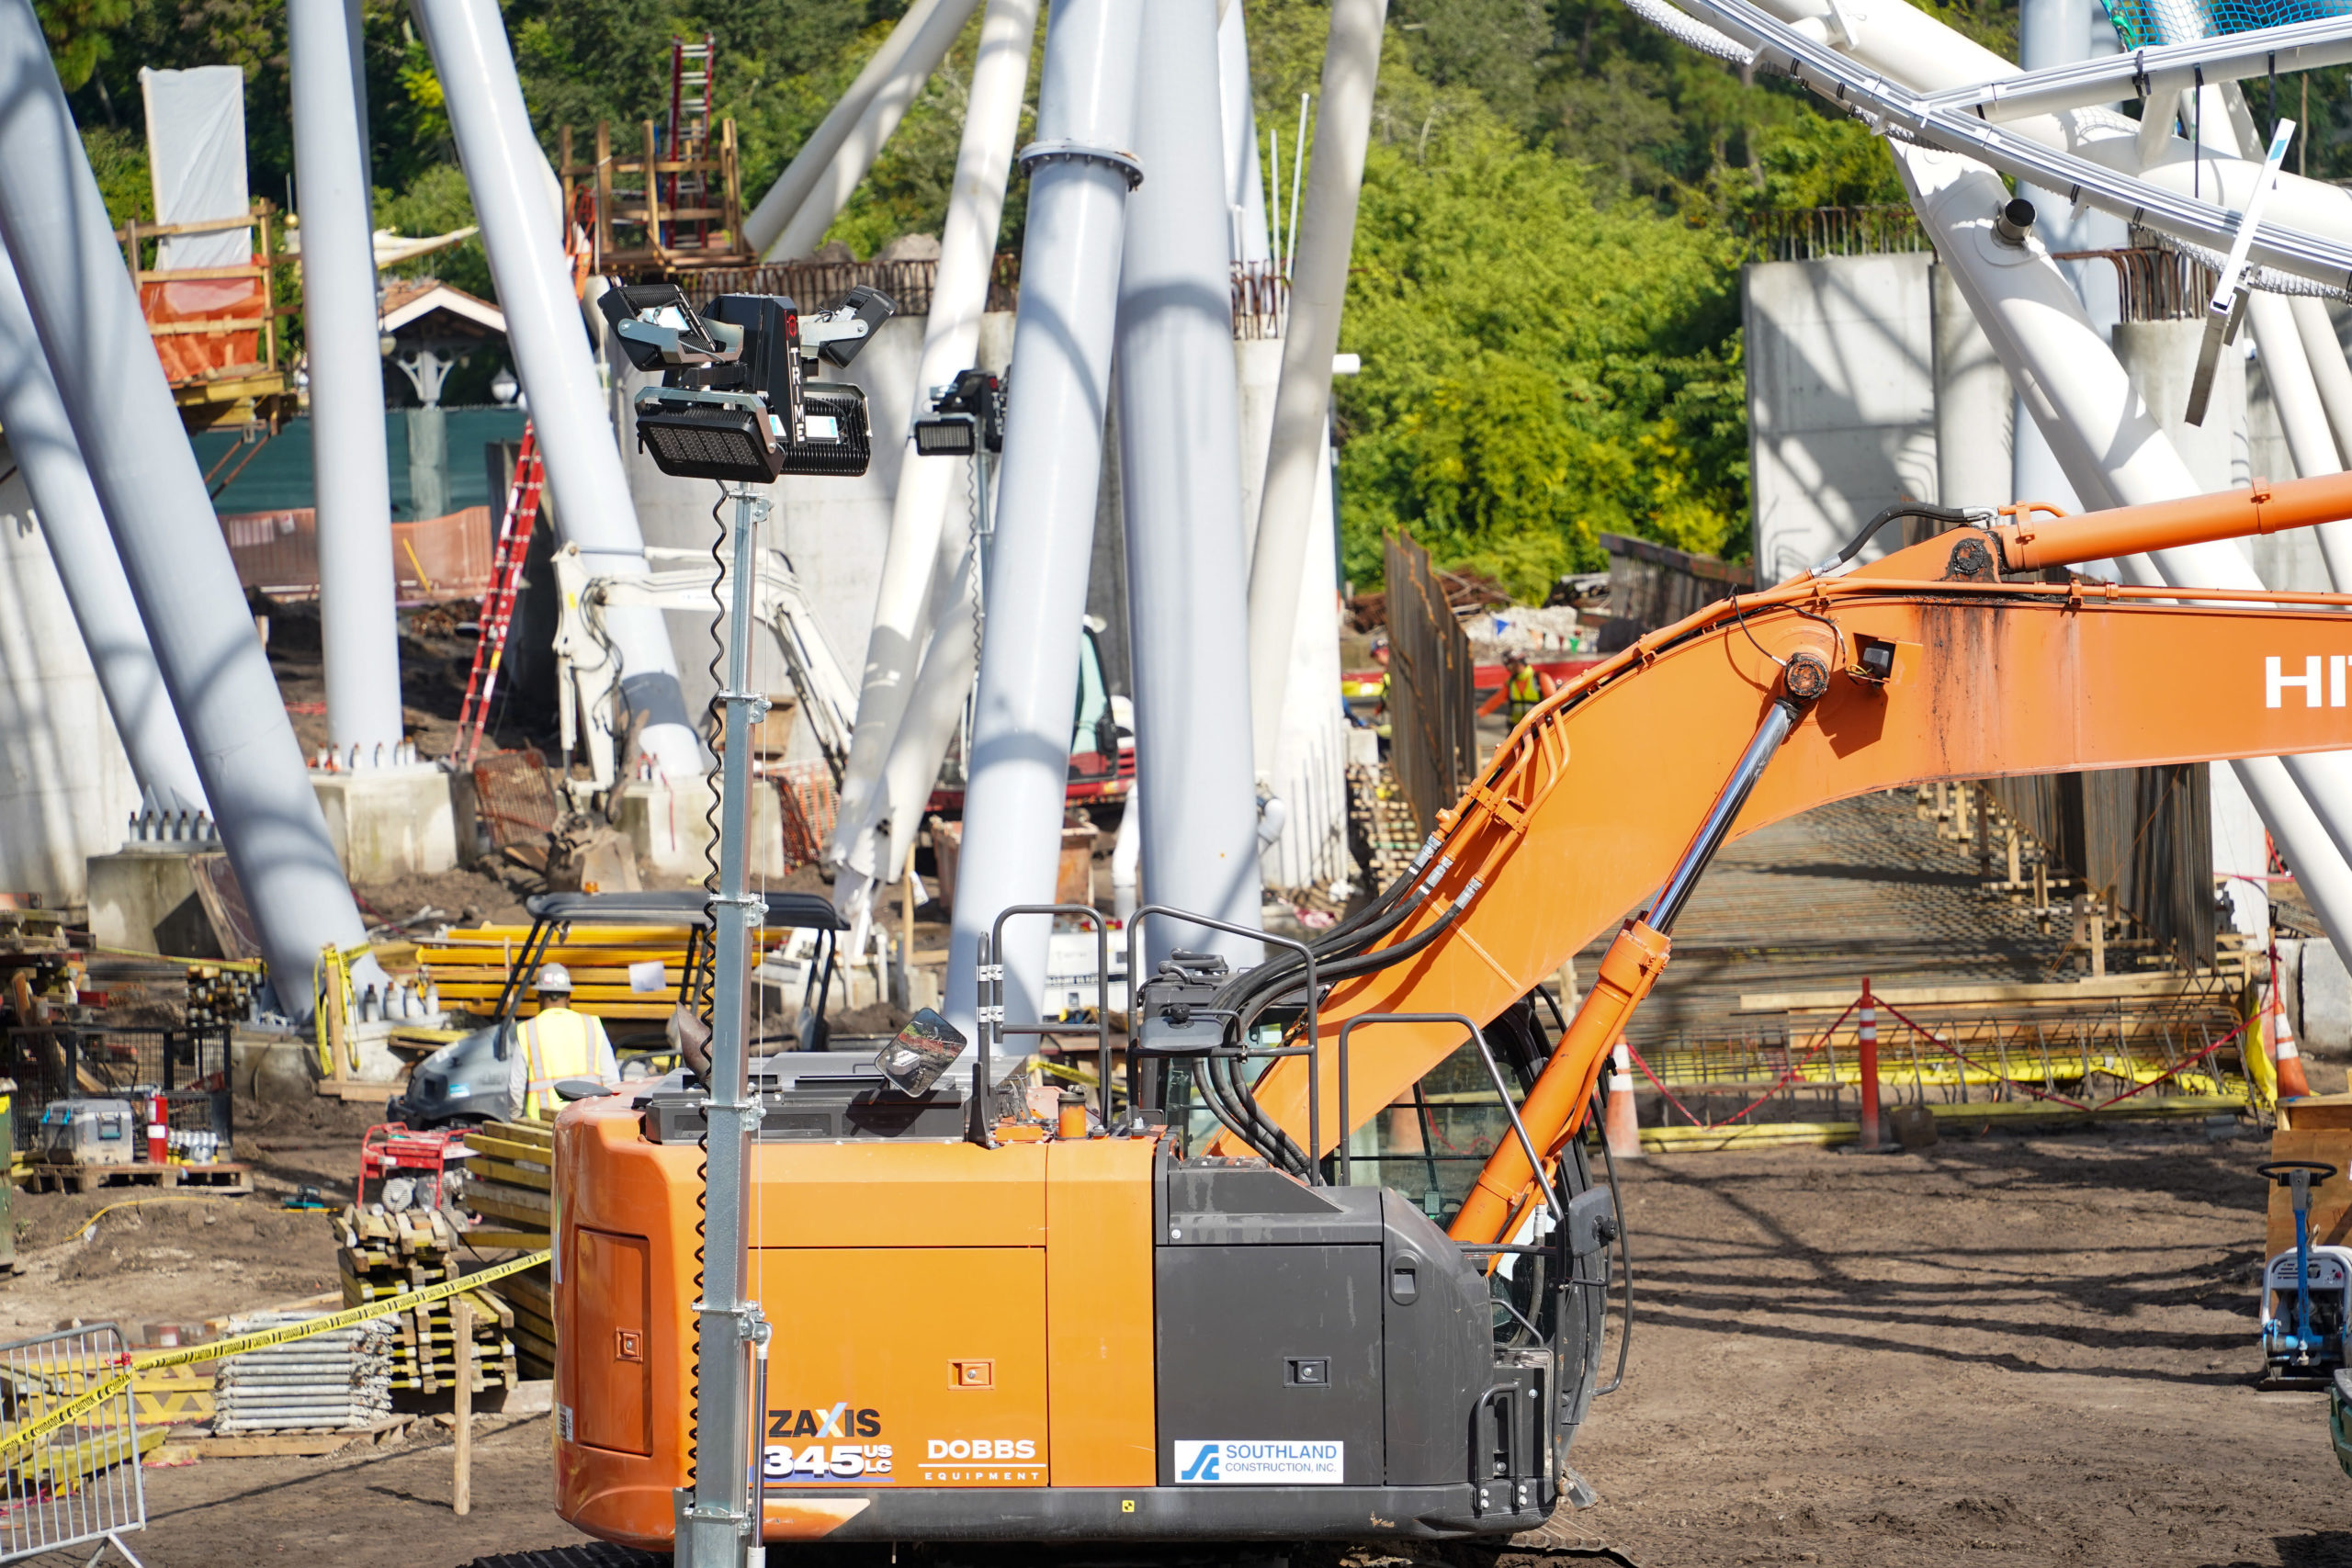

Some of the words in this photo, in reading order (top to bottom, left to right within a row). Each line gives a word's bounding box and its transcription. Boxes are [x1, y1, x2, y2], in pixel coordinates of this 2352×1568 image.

[790, 347, 806, 442] TRIME
[2266, 655, 2352, 708] HI
[194, 1348, 212, 1359] CAUTION
[223, 1342, 243, 1353] CUIDADO
[252, 1335, 271, 1347] CAUTION
[281, 1327, 301, 1339] CUIDADO
[310, 1321, 329, 1332] CAUTION
[368, 1303, 387, 1315] CAUTION
[34, 1416, 61, 1434] CUIDADO
[72, 1395, 96, 1413] CAUTION
[768, 1402, 882, 1438] ZAXIS
[763, 1444, 865, 1478] 345
[864, 1444, 893, 1458] US
[865, 1459, 893, 1473] LC
[927, 1439, 1036, 1459] DOBBS
[1226, 1444, 1337, 1459] SOUTHLAND
[925, 1472, 1040, 1480] EQUIPMENT
[1225, 1462, 1314, 1473] CONSTRUCTION,
[1316, 1462, 1337, 1472] INC.
